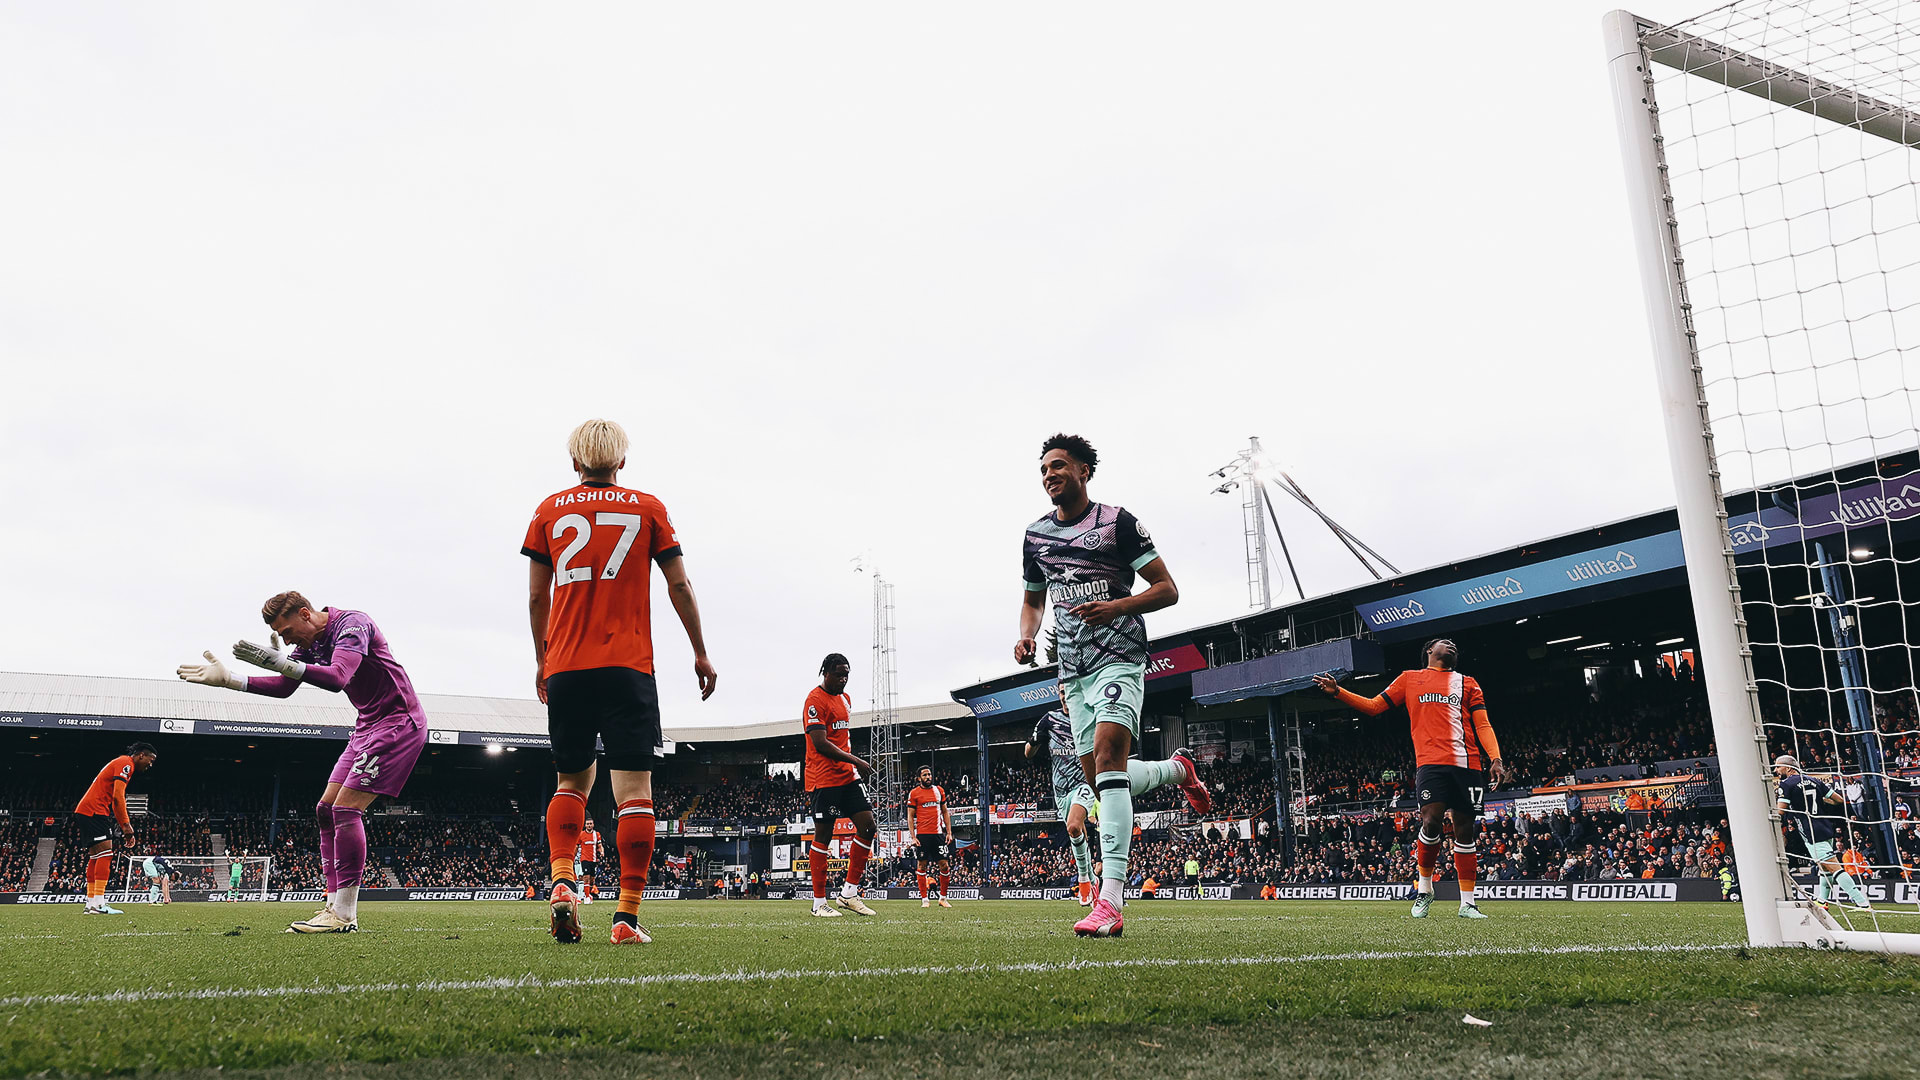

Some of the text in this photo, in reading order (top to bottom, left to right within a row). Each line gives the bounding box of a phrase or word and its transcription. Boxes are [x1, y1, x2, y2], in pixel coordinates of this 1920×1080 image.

[554, 490, 640, 508] HASHIOKA
[552, 511, 642, 587] 27
[1566, 559, 1622, 582] utilita
[1461, 584, 1511, 605] utilita
[1370, 606, 1414, 625] utilita
[1157, 657, 1175, 671] FC
[1020, 687, 1049, 703] PROUD
[1104, 683, 1122, 704] 9
[1418, 693, 1449, 703] utilita
[58, 718, 78, 726] 01582
[213, 724, 322, 736] WWW.QUINNGROUNDWORKS.CO.UK
[351, 751, 381, 780] 24
[1077, 787, 1091, 800] 12
[1468, 786, 1484, 804] 17
[938, 845, 949, 855] 30
[408, 892, 473, 900] SKECHERS
[1000, 889, 1042, 899] SKECHERS
[1275, 887, 1337, 899] KECHERS
[1473, 884, 1673, 899] SKECHERS FOOTBALL
